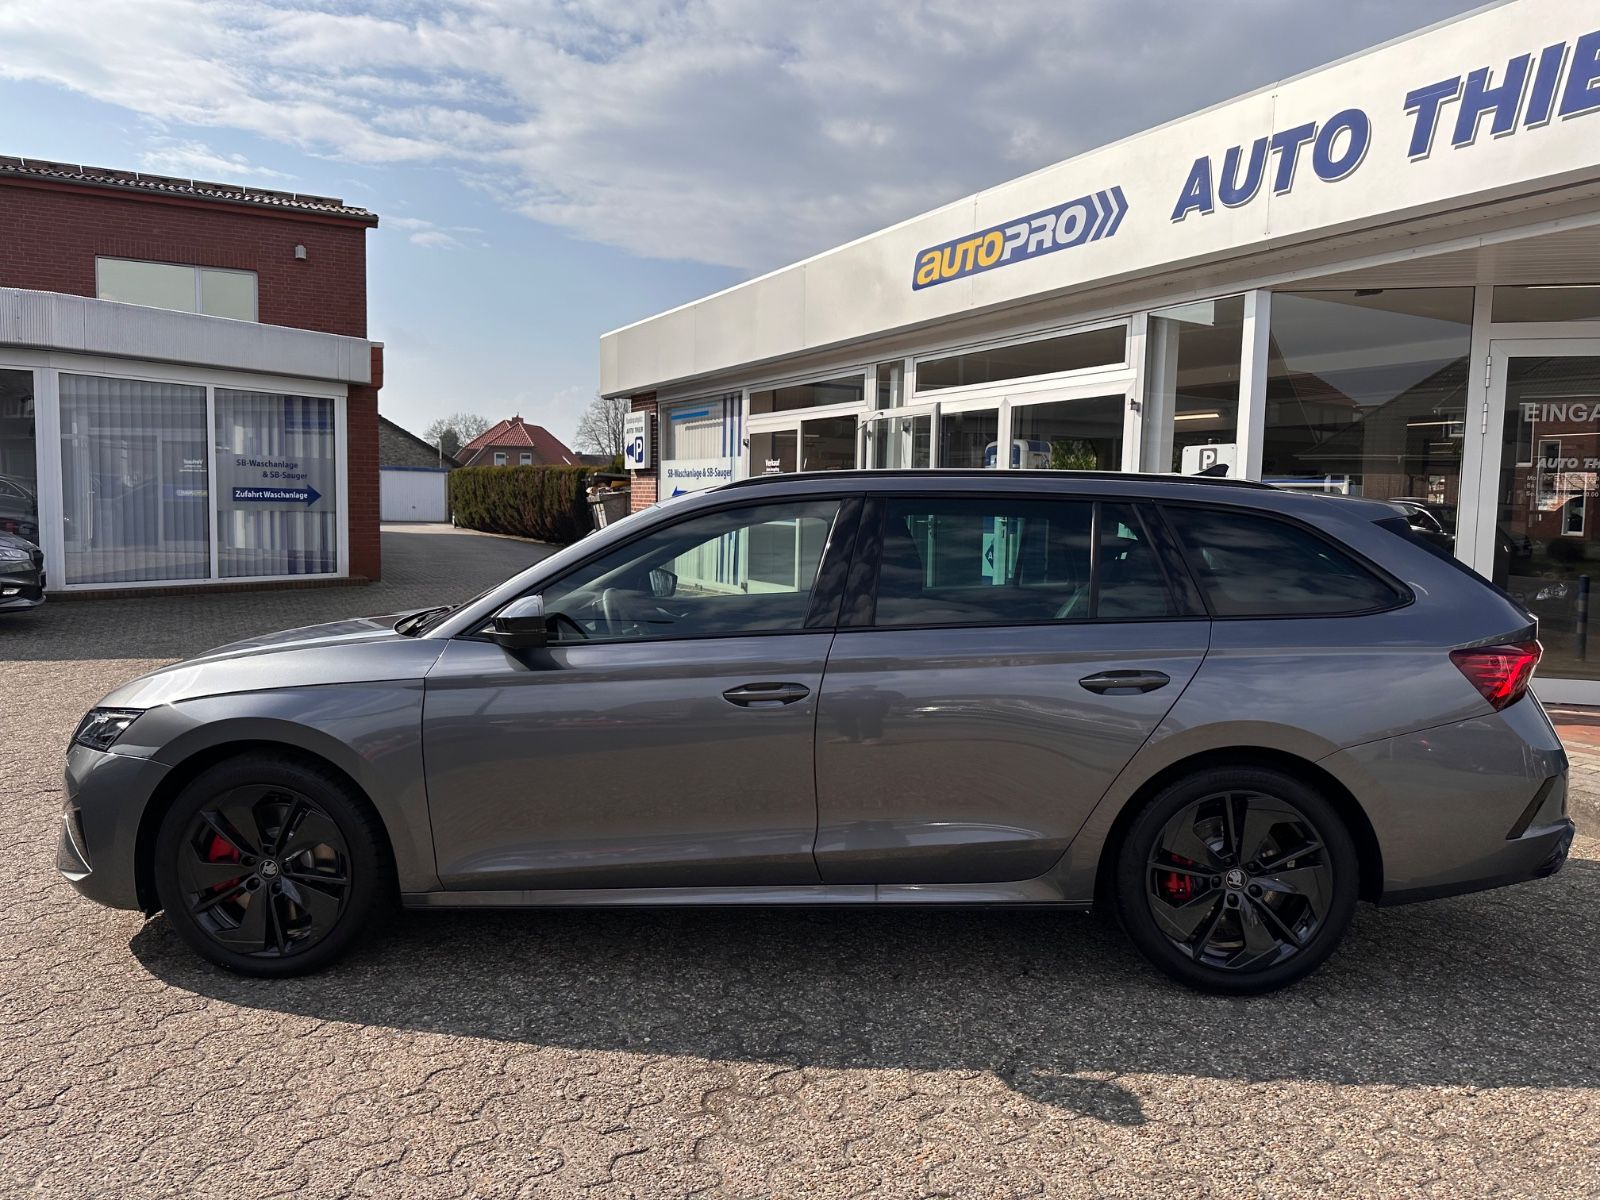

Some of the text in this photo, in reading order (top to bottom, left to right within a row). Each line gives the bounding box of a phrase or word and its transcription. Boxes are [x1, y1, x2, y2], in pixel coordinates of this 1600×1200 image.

[1170, 30, 1600, 224] AUTO THIE
[635, 439, 643, 461] P
[236, 459, 298, 470] SB-Waschanlage
[1202, 450, 1215, 470] P
[1536, 458, 1579, 469] AUTO
[262, 470, 308, 480] & SB-Sauger
[667, 467, 732, 480] SB-Waschanlage & SB-Sauger
[235, 489, 308, 500] Zufahrt Waschanlage
